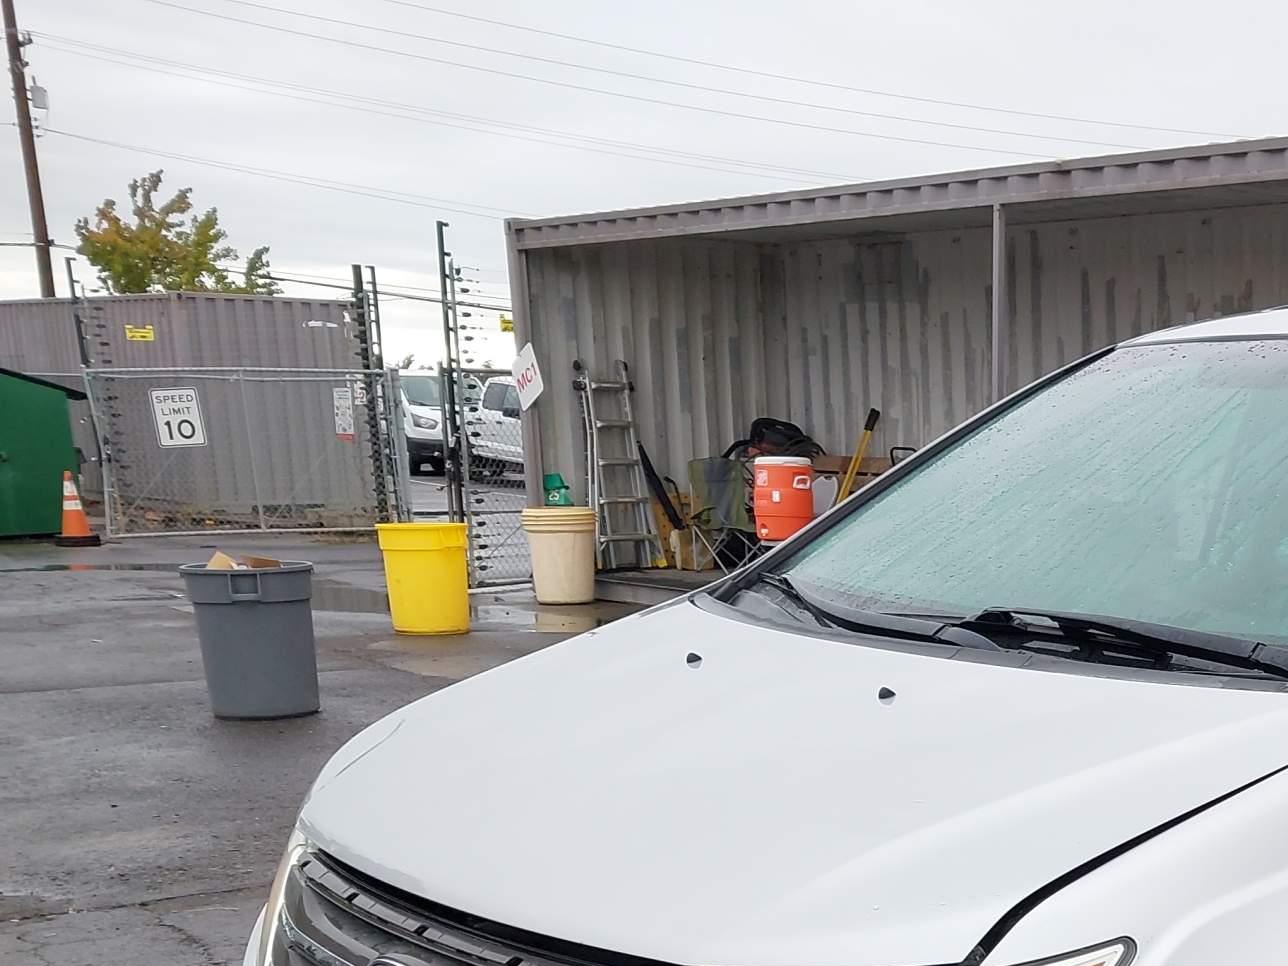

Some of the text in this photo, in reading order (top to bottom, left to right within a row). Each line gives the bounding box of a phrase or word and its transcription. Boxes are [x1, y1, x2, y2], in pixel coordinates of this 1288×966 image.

[516, 361, 538, 393] MC1
[154, 394, 194, 404] SPEED
[160, 406, 192, 416] LIMIT
[163, 419, 196, 440] 10
